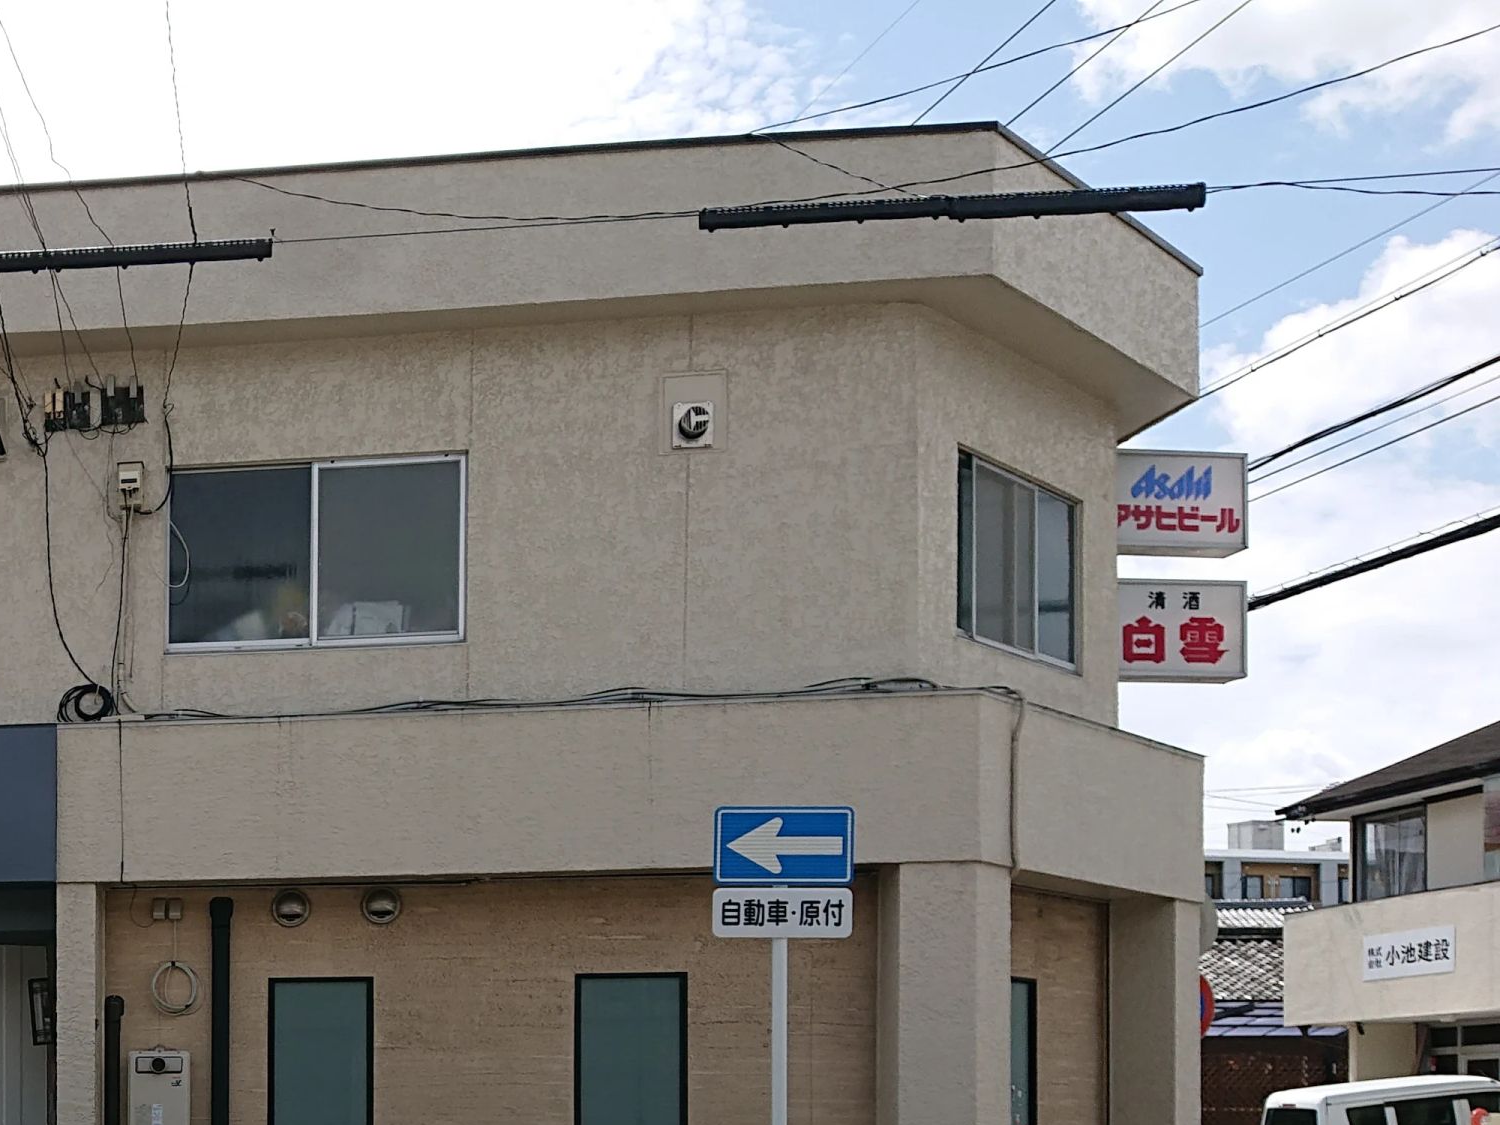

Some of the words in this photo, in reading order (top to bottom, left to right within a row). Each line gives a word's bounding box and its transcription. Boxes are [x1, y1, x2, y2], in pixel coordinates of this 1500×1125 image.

[1131, 464, 1212, 500] Asahi
[1148, 591, 1200, 610] 清酒
[1122, 616, 1229, 664] 白雪
[1385, 938, 1450, 966] 小池建設
